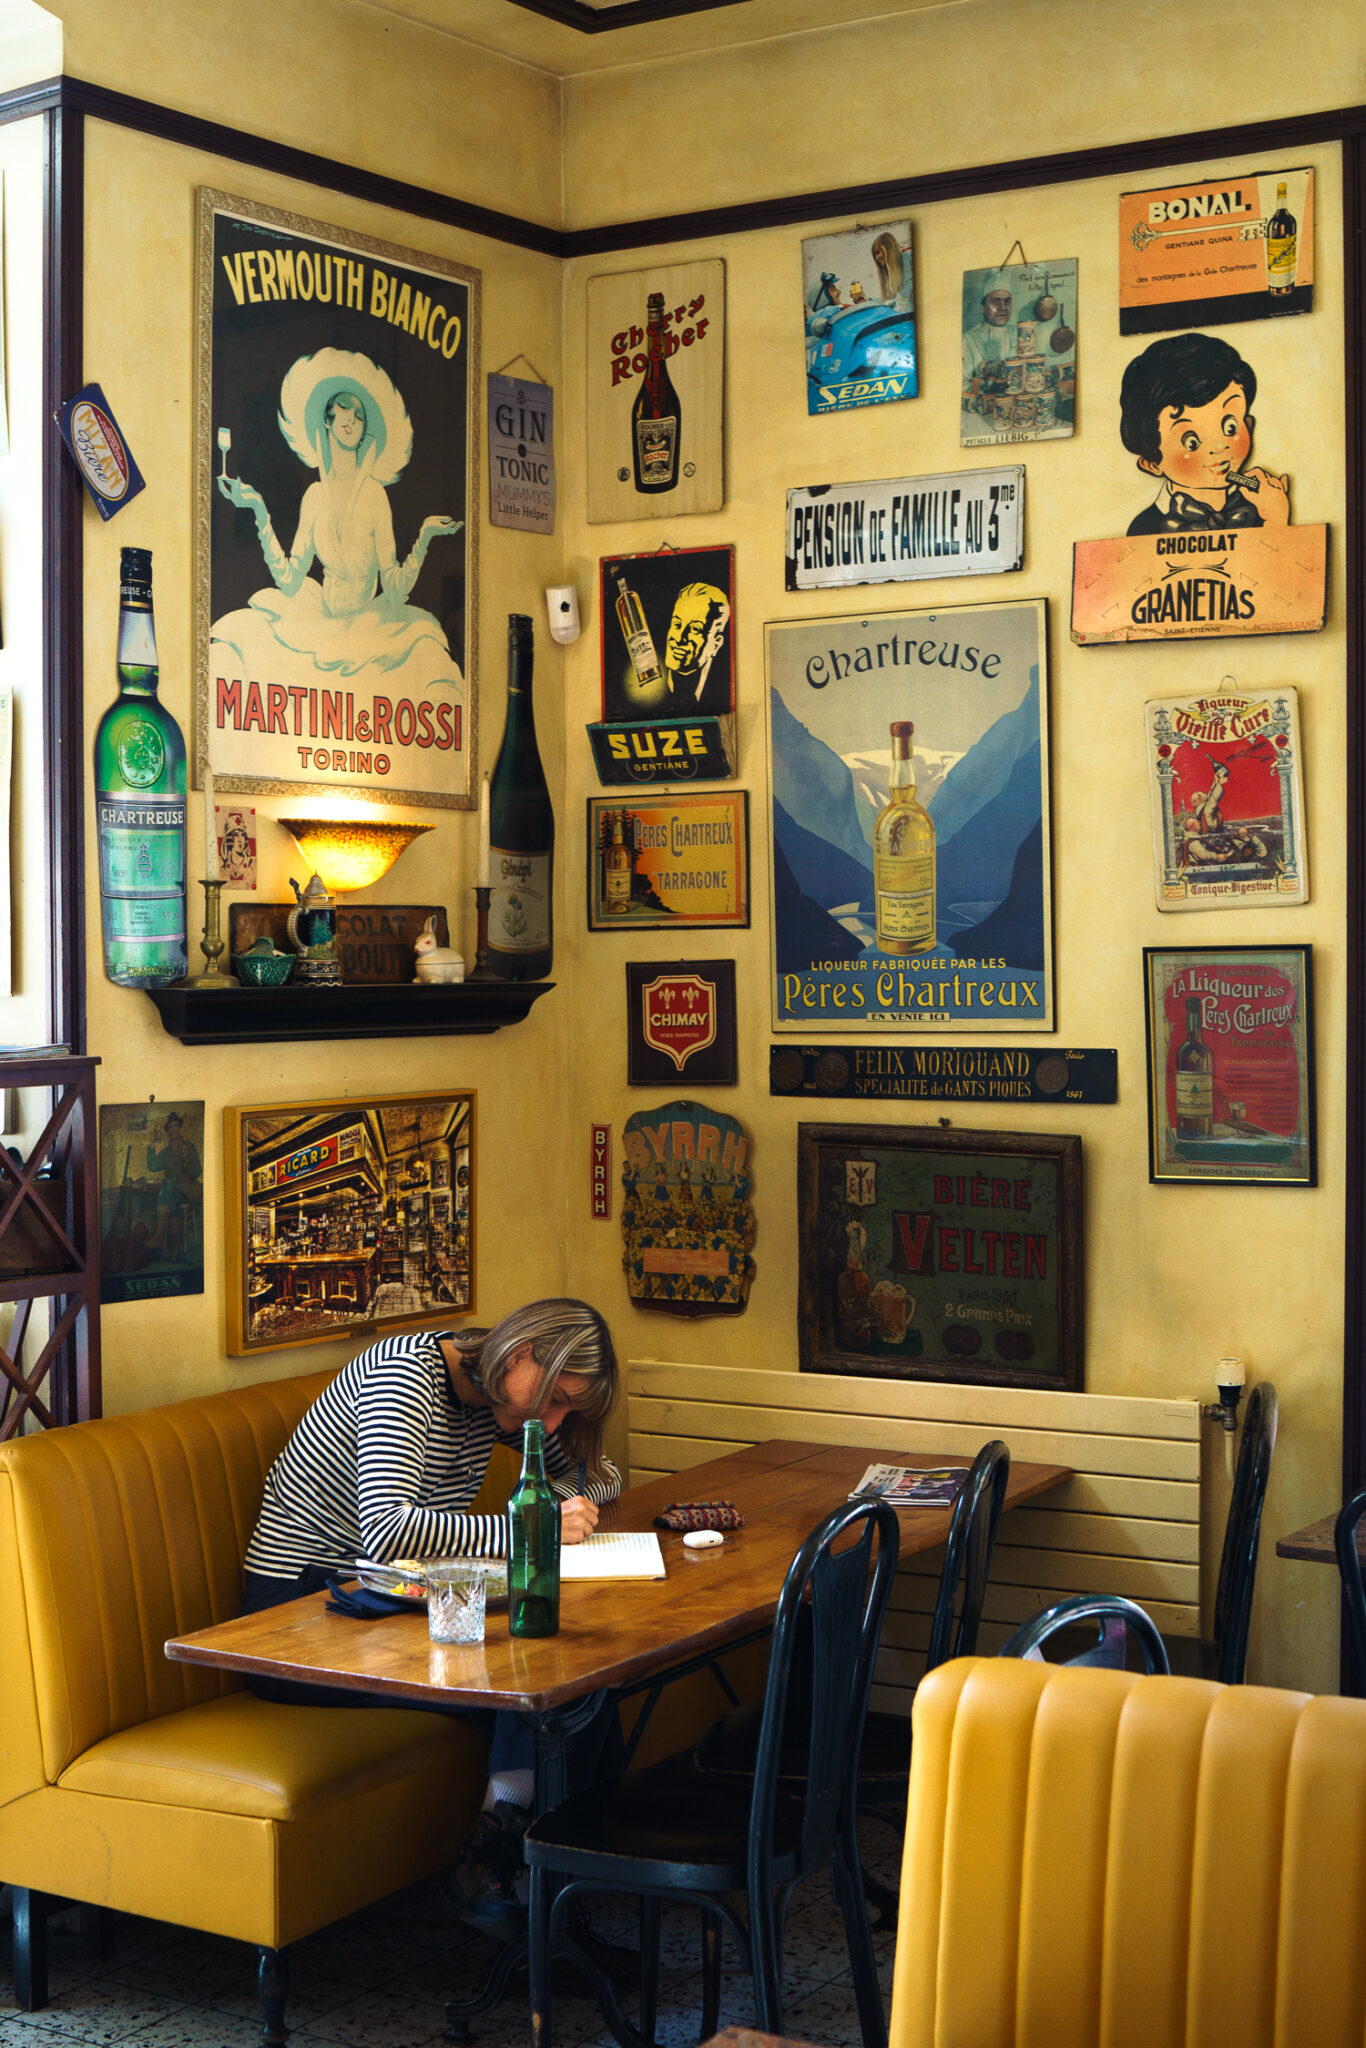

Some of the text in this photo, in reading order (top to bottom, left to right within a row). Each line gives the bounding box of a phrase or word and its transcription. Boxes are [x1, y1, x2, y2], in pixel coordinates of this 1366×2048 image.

[1165, 235, 1233, 250] GENTIANE QUINA
[1136, 276, 1149, 284] des
[1151, 272, 1187, 282] montagnes
[1219, 263, 1258, 274] Chartreuse
[222, 249, 462, 360] VERMOUTH BIANCO
[611, 293, 705, 356] Cherry
[611, 317, 710, 387] Rocher
[817, 373, 908, 407] SEDAN
[496, 404, 547, 445] GIN
[995, 431, 1029, 443] LIEBIG
[78, 407, 123, 491] MIZAN
[496, 455, 549, 485] TONIC
[498, 484, 550, 506] MUMMY'S
[498, 502, 549, 521] Little Helper
[794, 500, 865, 570] PENSION
[869, 509, 886, 563] DE
[892, 489, 961, 561] FAMILLE
[965, 499, 983, 554] AU
[1156, 534, 1238, 555] CHOCOLAT
[1131, 578, 1256, 624] GRANETIAS
[805, 633, 1002, 690] Chartreuse
[1195, 699, 1248, 713] Liqueur
[607, 728, 708, 760] SUZE
[298, 747, 390, 775] TORINO
[633, 761, 690, 772] GENTIANE
[101, 808, 184, 825] CHARTREUSE
[670, 816, 733, 857] CHARTREUX
[811, 956, 1007, 973] LIQUEUR FABRIQUÉE PAR LES
[876, 972, 1040, 1008] Chartreux
[1172, 970, 1285, 998] LA Liqueur des
[650, 1013, 709, 1027] CHIMAY
[872, 1012, 945, 1021] EN VENTE ICI
[1233, 1003, 1293, 1034] Chartreux
[855, 1050, 1030, 1077] FELIX MORIQUAND
[931, 1081, 944, 1096] de
[945, 1080, 986, 1097] GANTS
[989, 1081, 1032, 1097] PIQUES
[279, 1145, 332, 1178] RICARD
[621, 1121, 749, 1175] BYRRH
[595, 1130, 607, 1216] BYRRH
[933, 1170, 1032, 1212] BIÈRE
[895, 1213, 1048, 1280] VELTEN
[124, 1276, 181, 1295] SEDAN
[944, 1302, 954, 1317] 2
